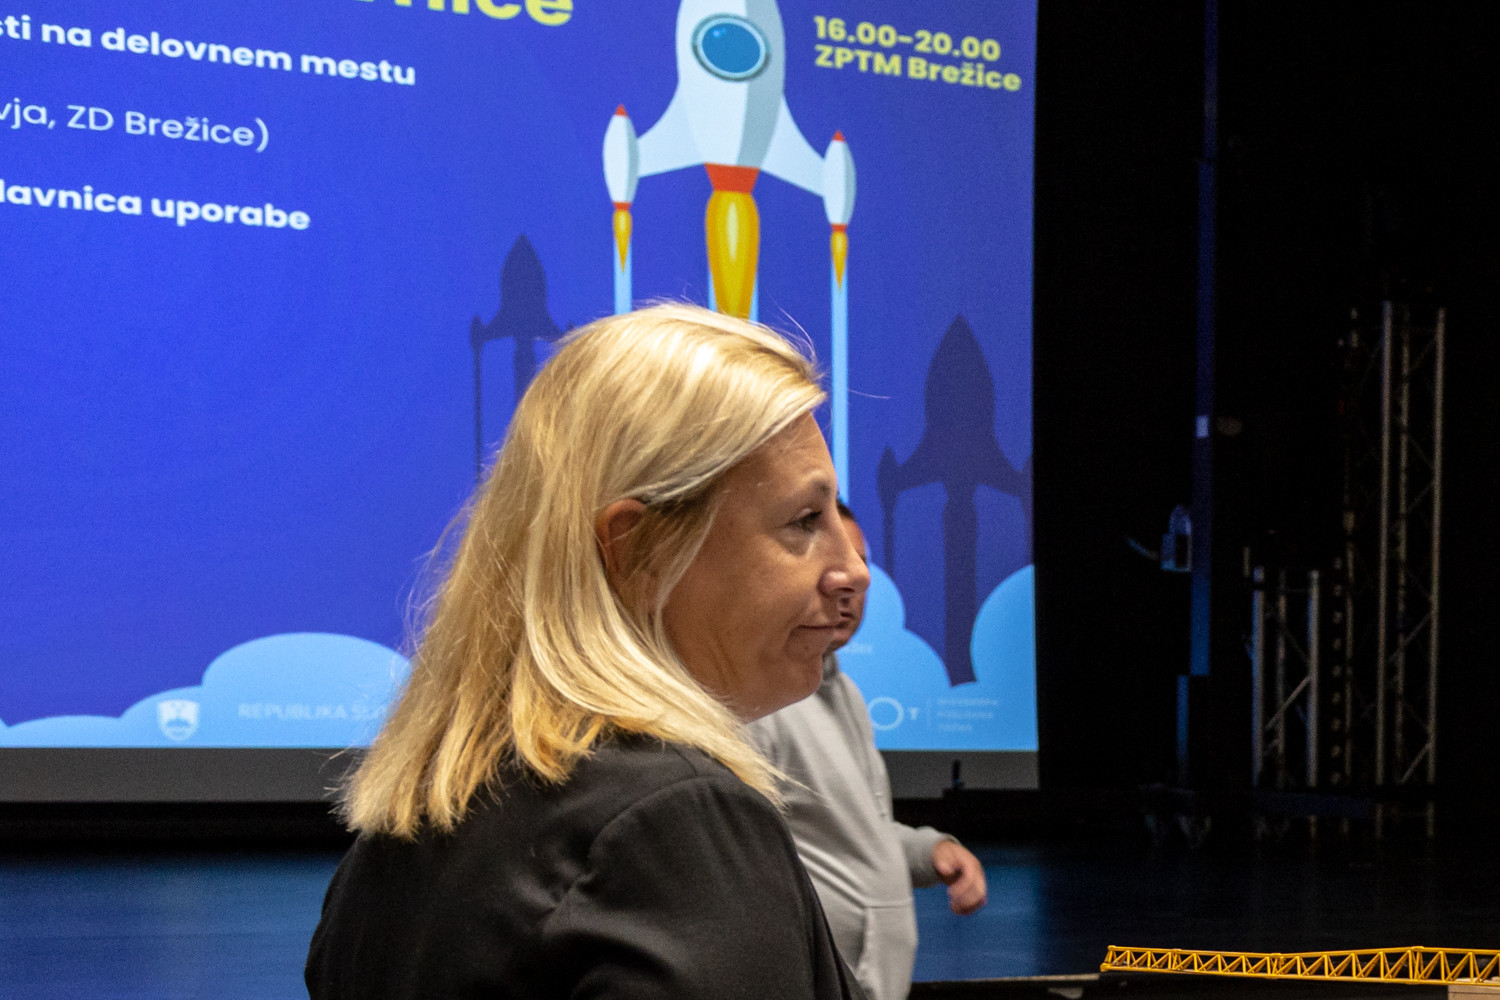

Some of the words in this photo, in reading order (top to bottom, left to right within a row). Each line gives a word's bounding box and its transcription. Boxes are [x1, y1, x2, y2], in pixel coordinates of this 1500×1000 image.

[0, 14, 31, 41] ti
[41, 23, 92, 48] na
[100, 27, 293, 72] delovnem
[300, 49, 417, 86] mestu
[814, 45, 902, 77] ZPTM
[908, 56, 1022, 92] Brežice
[66, 104, 114, 131] ZD
[125, 110, 269, 153] Brežice)
[150, 198, 311, 230] uporabe
